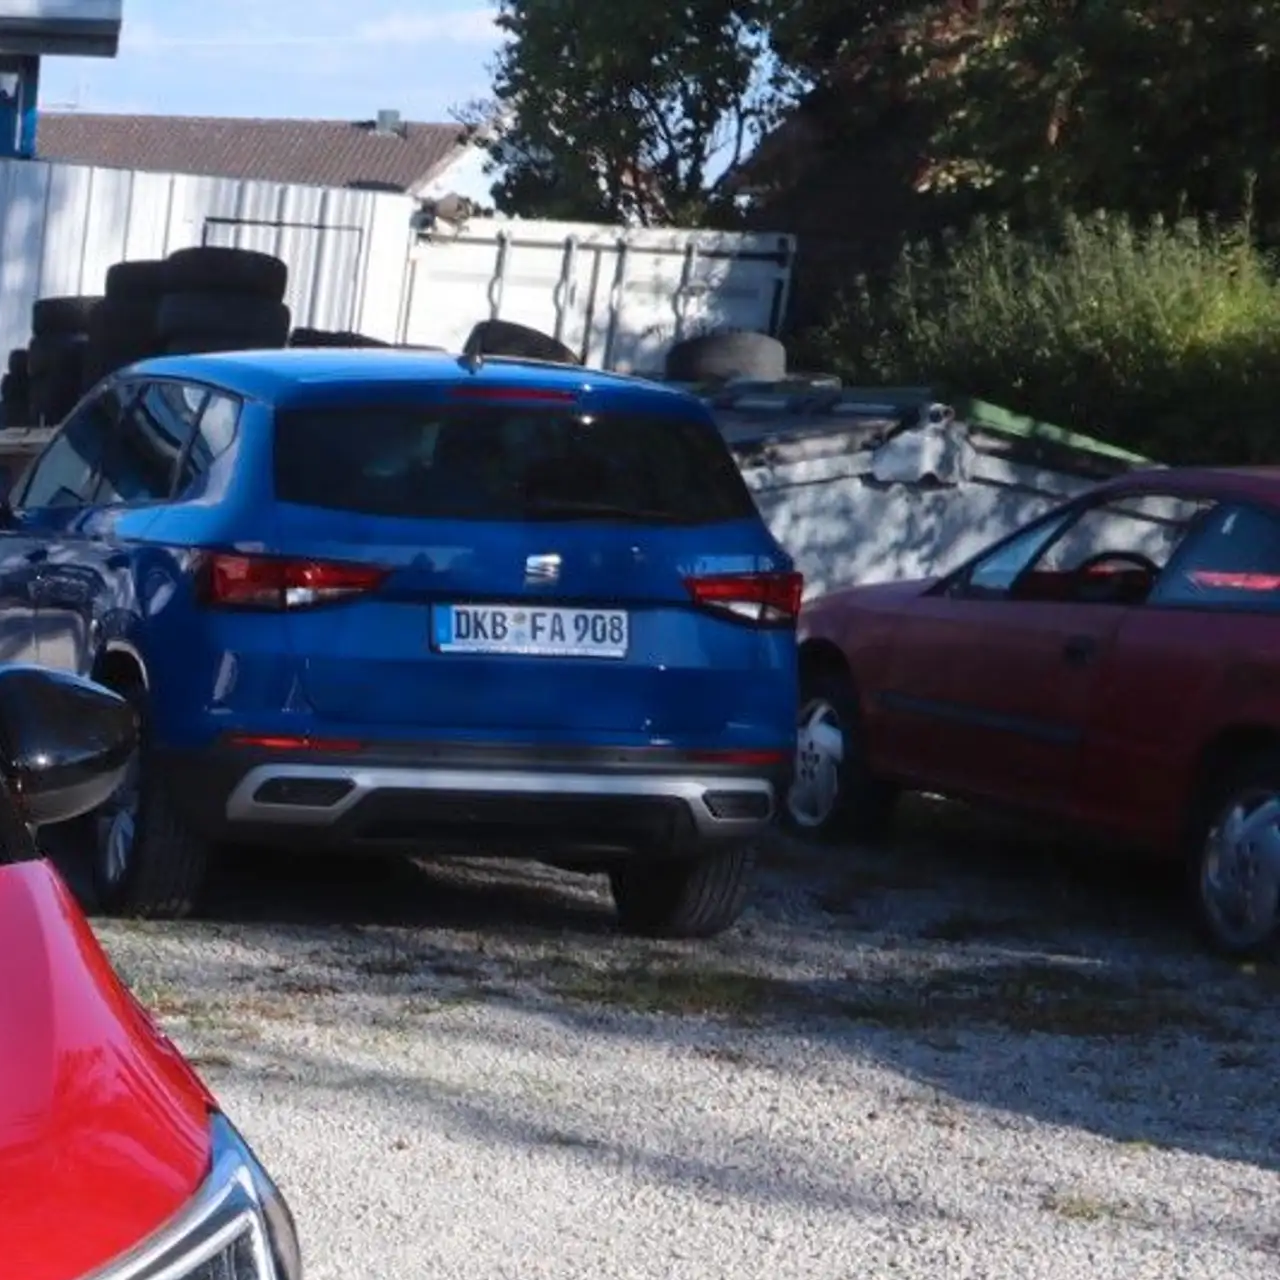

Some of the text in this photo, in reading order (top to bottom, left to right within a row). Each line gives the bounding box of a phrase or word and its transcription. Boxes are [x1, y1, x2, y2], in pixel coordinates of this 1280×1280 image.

[454, 608, 625, 645] DKB FA 908
